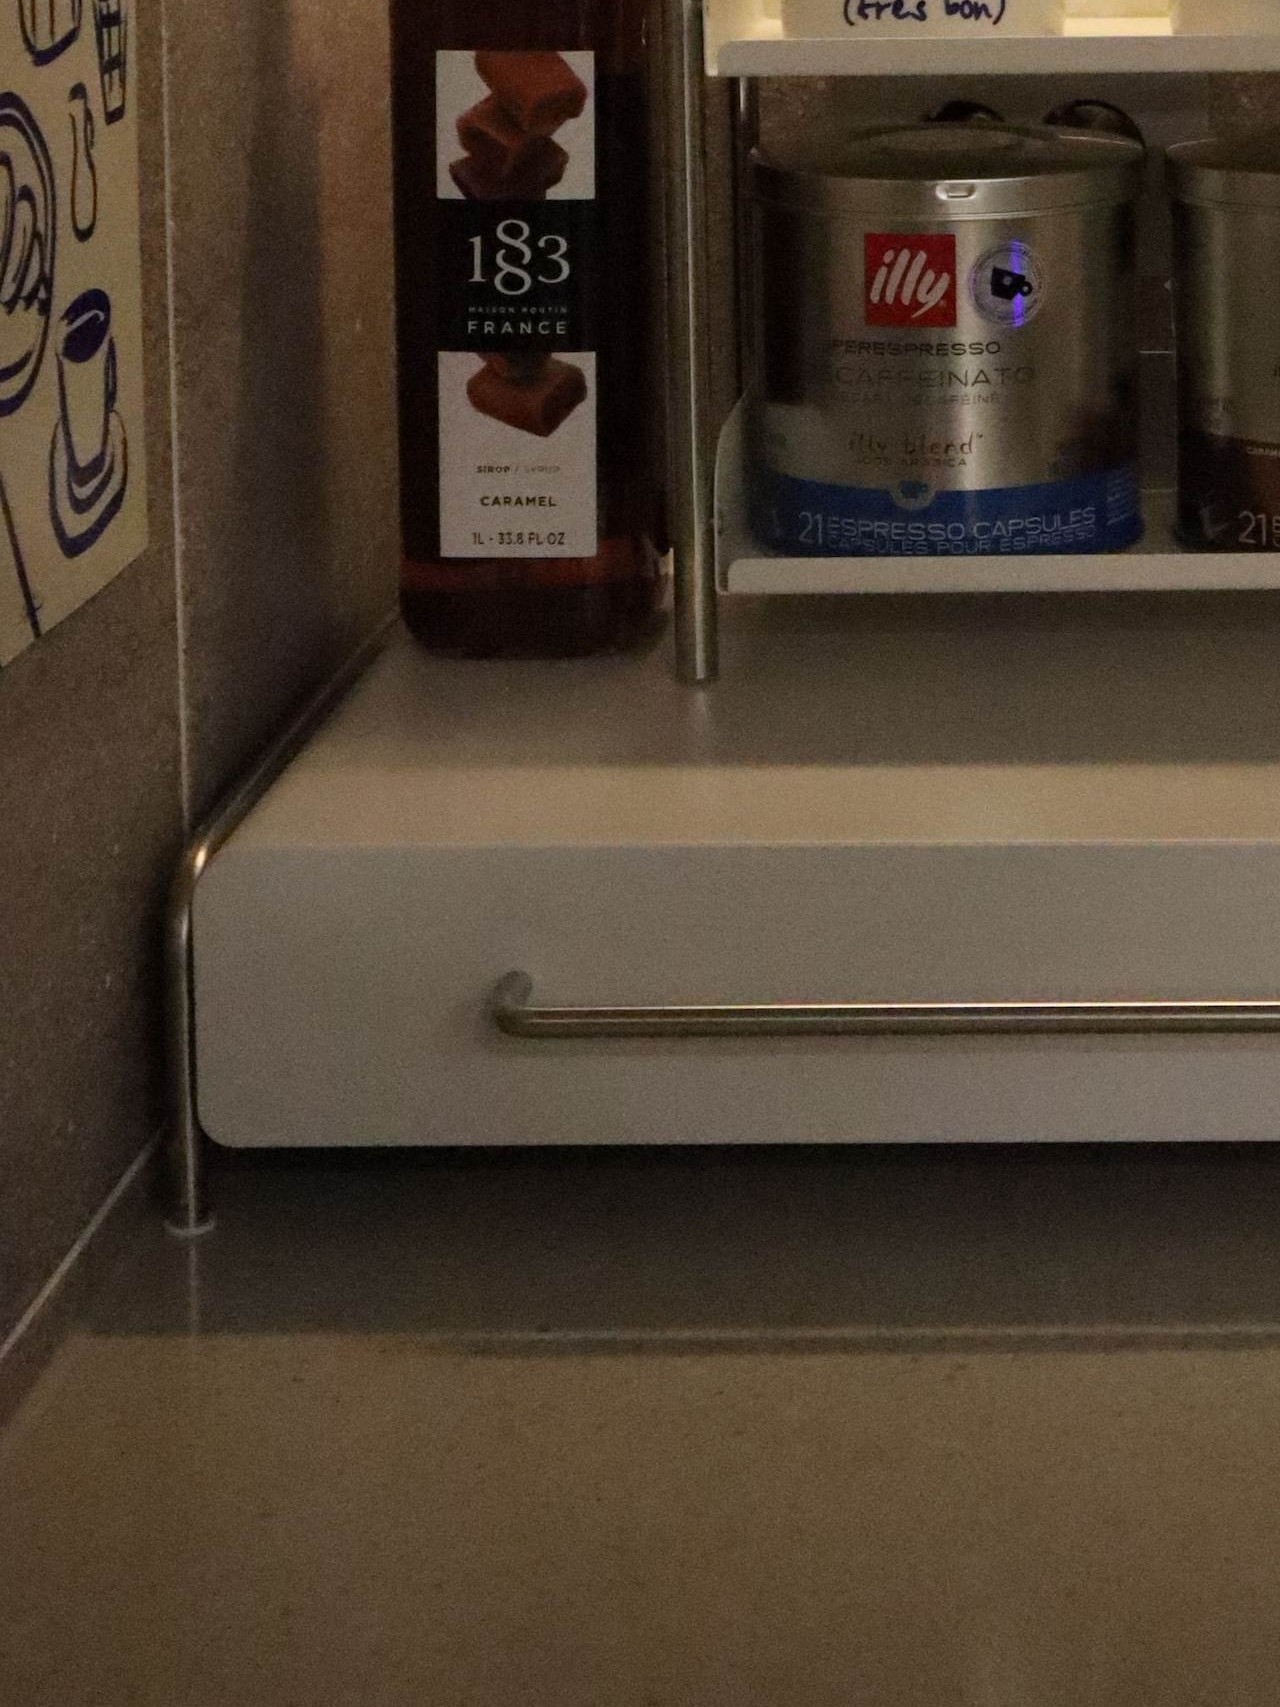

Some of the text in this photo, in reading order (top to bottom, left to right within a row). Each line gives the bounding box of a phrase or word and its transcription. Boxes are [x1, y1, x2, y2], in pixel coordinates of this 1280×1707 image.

[869, 247, 952, 320] illy
[467, 320, 568, 335] FRANCE
[475, 464, 511, 474] SIROP
[479, 495, 557, 507] CARAMEL
[797, 506, 1098, 546] 21 ESPRESSO CAPSULES
[1238, 509, 1267, 546] 21
[472, 531, 485, 546] 1L
[498, 531, 524, 546] 33.8
[527, 531, 544, 546] FL
[546, 531, 566, 546] OZ
[936, 539, 992, 556] POUR
[1000, 523, 1098, 553] ESPRESSO
